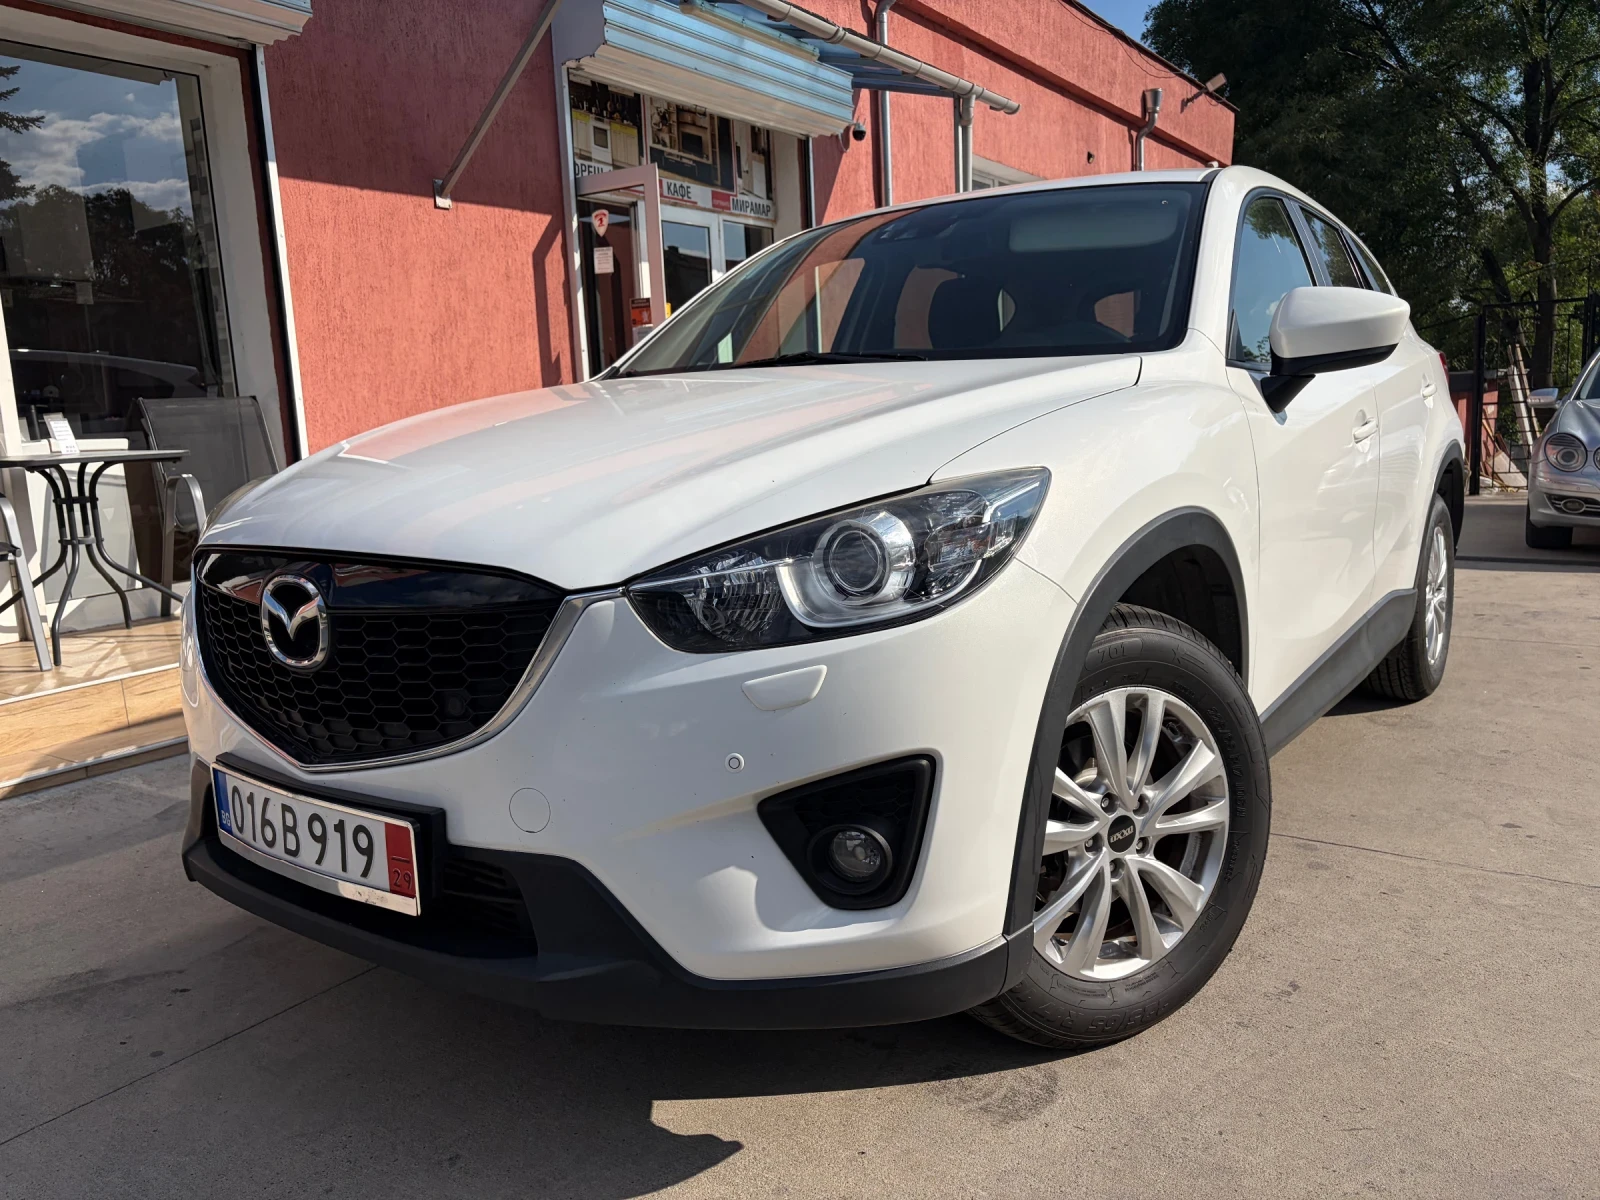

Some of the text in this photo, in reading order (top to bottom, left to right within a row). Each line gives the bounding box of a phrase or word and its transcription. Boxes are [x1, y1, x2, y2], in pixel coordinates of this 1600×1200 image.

[666, 181, 692, 200] КАФЕ
[731, 197, 771, 217] МИРАМАР
[221, 809, 231, 828] BG
[392, 868, 413, 890] 29
